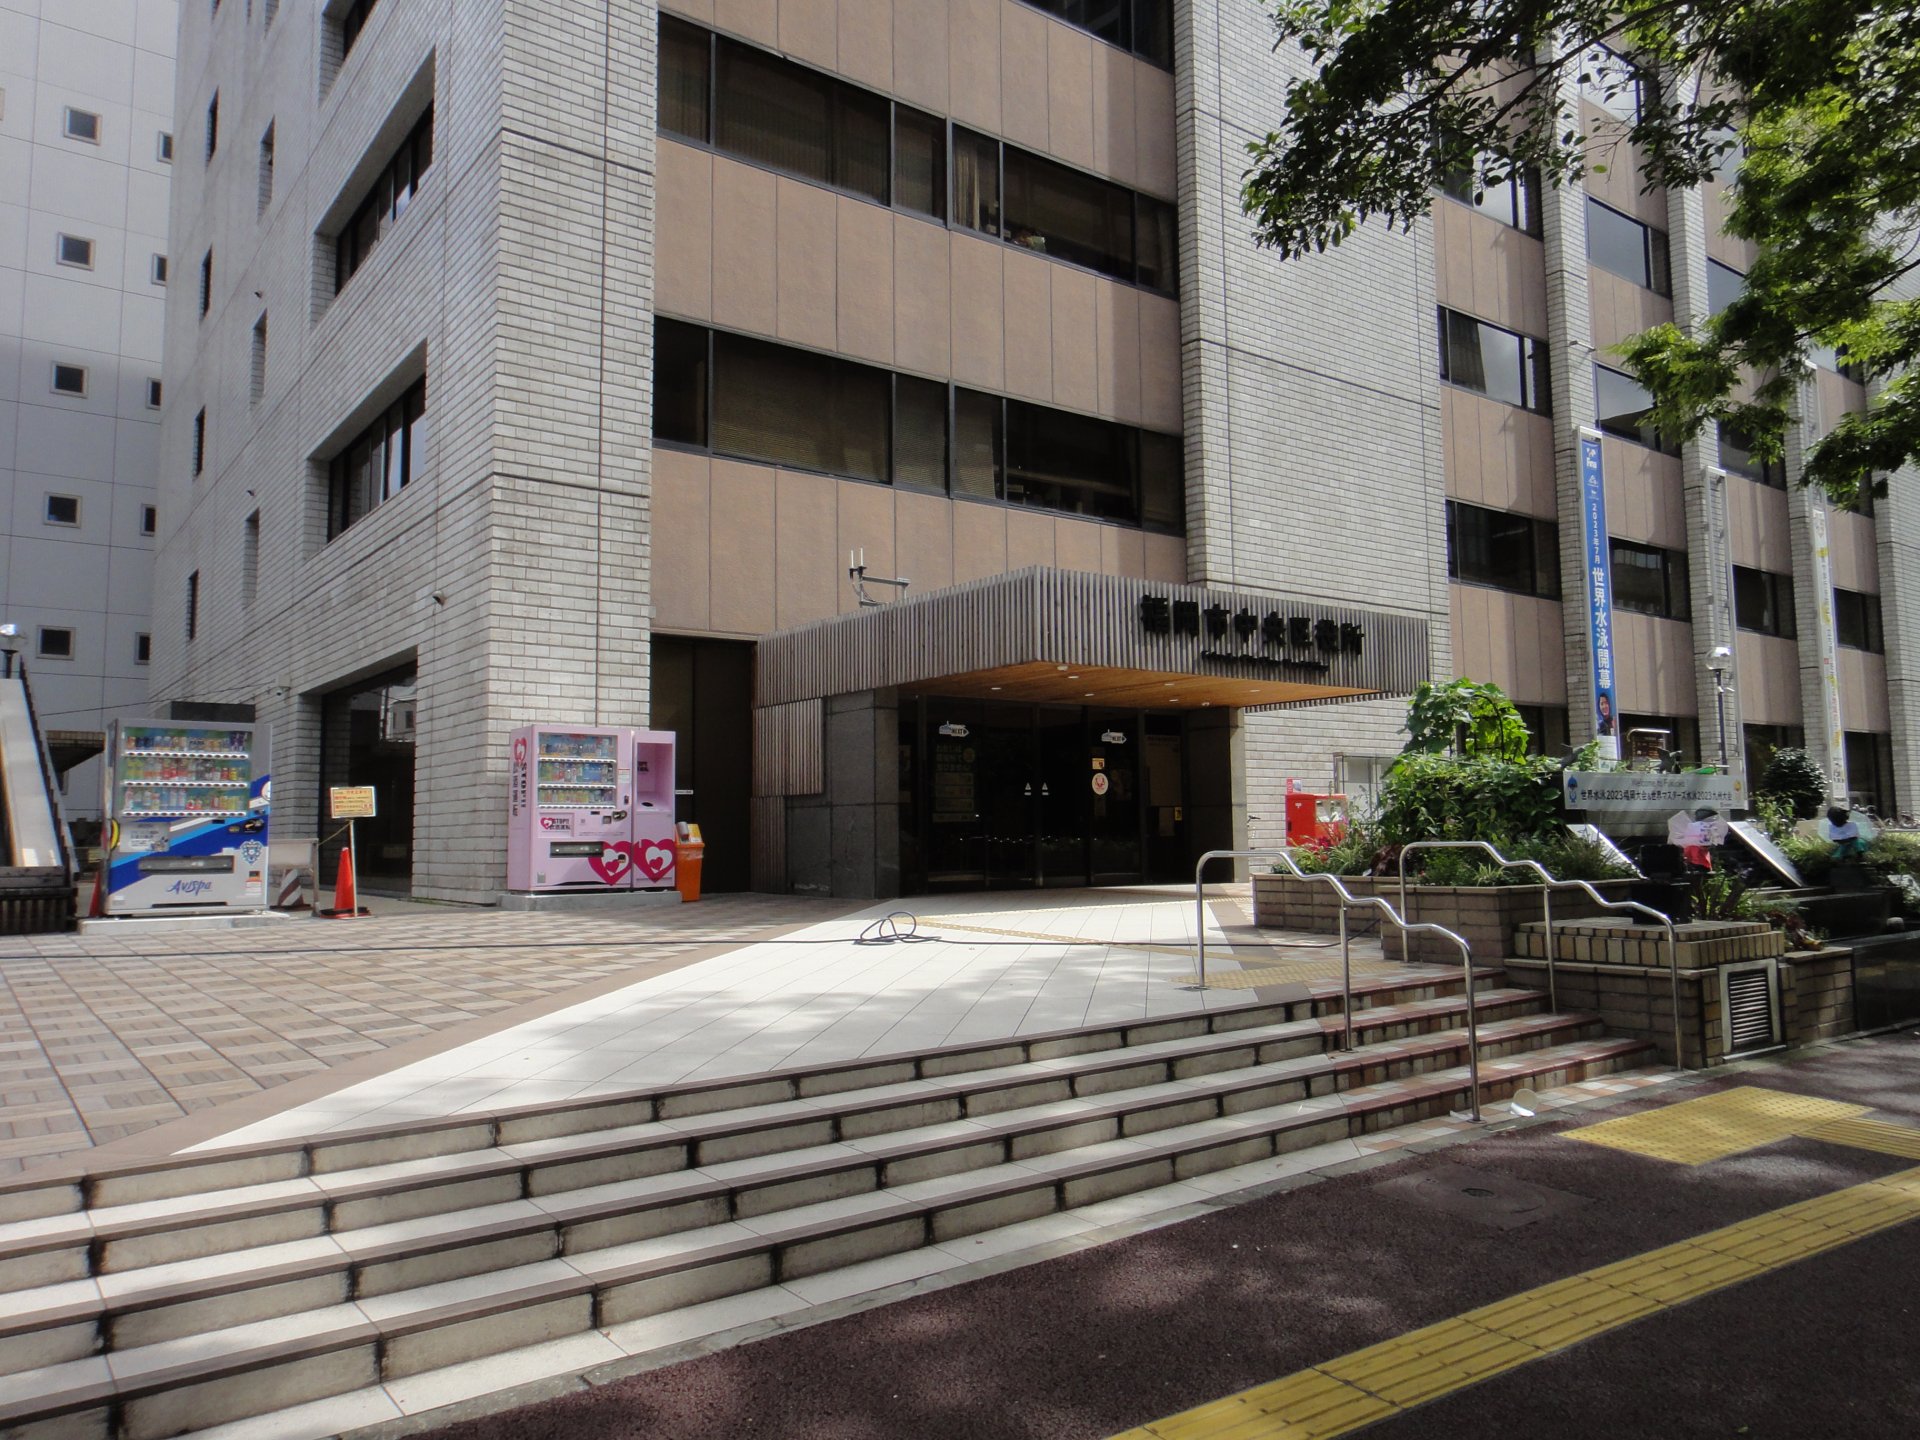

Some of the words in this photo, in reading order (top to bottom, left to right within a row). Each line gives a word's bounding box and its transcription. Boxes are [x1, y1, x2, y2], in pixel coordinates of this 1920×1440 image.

[1591, 503, 1600, 564] 2023年7月
[1141, 594, 1364, 655] 福岡市中央区役所
[1592, 567, 1611, 688] 世界水泳開幕
